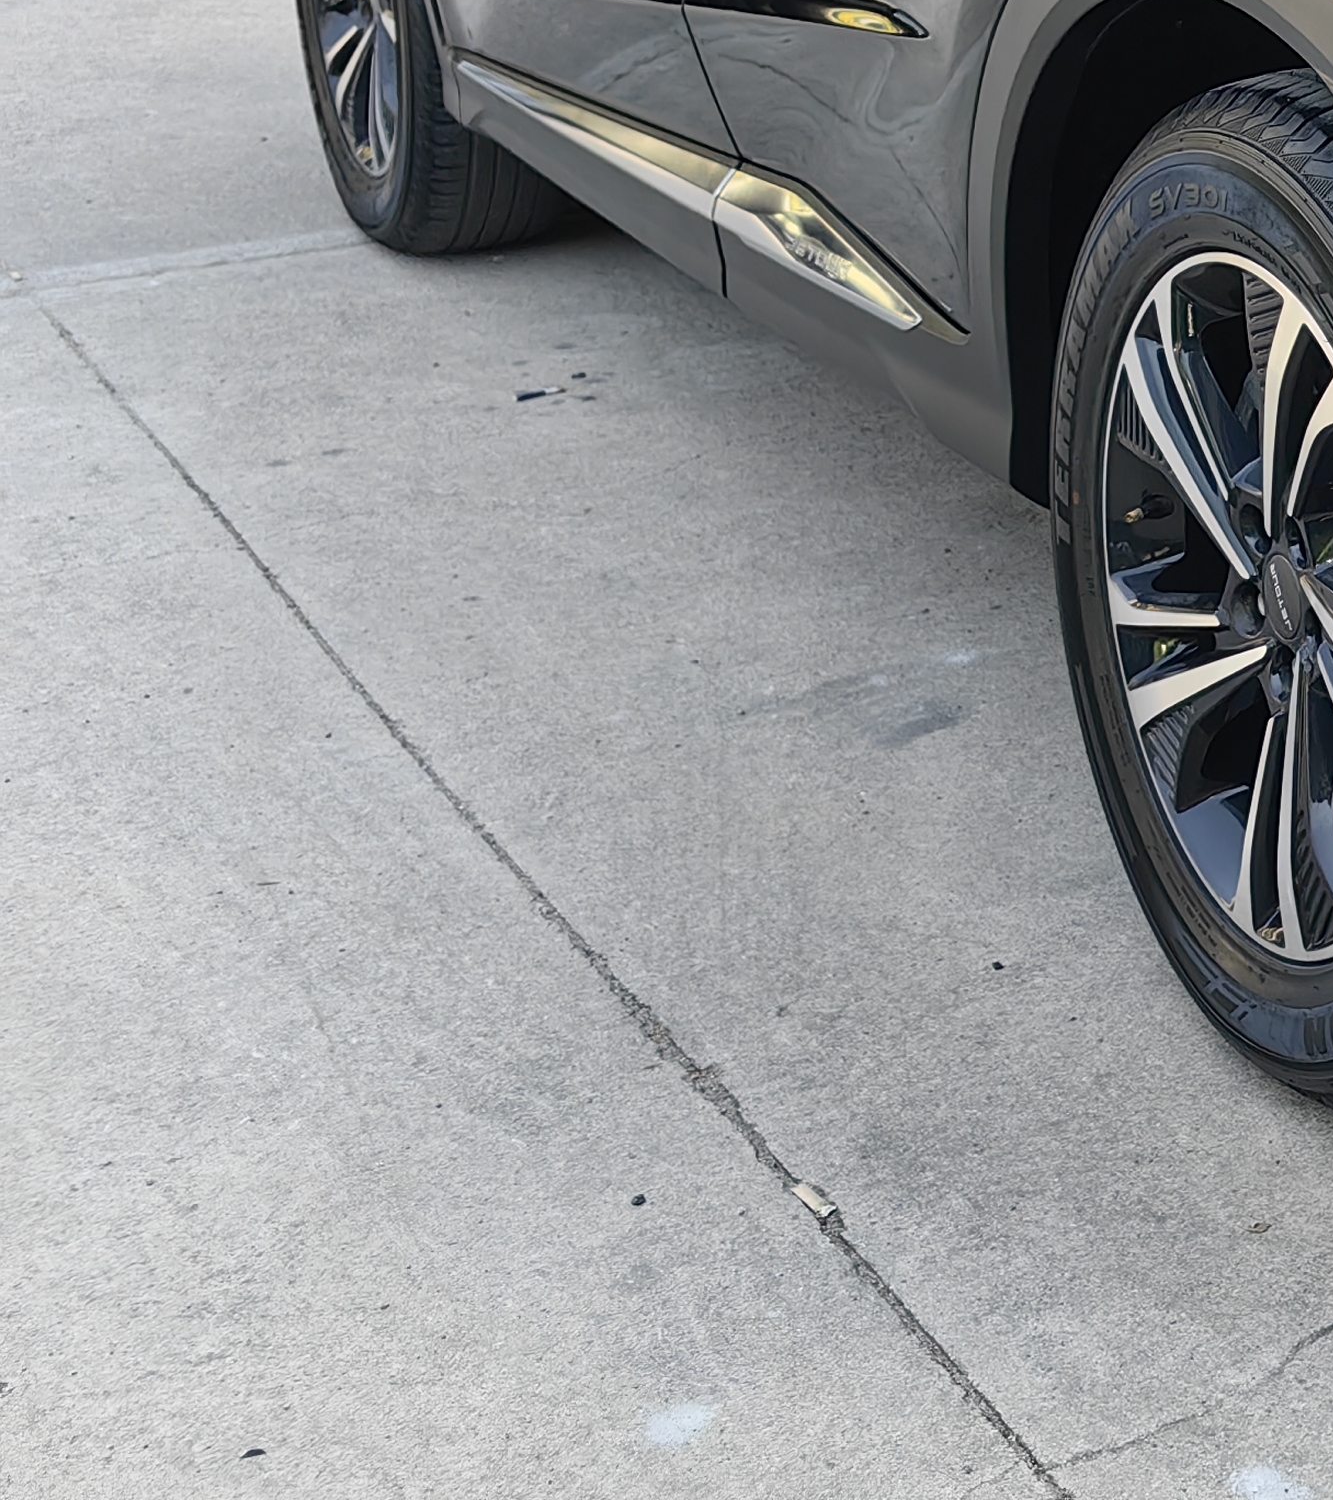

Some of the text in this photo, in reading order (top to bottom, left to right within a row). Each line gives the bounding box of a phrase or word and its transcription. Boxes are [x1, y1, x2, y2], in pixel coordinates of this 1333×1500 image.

[1053, 183, 1231, 547] TERRAMAX SV301
[1268, 561, 1294, 632] JETOUR
